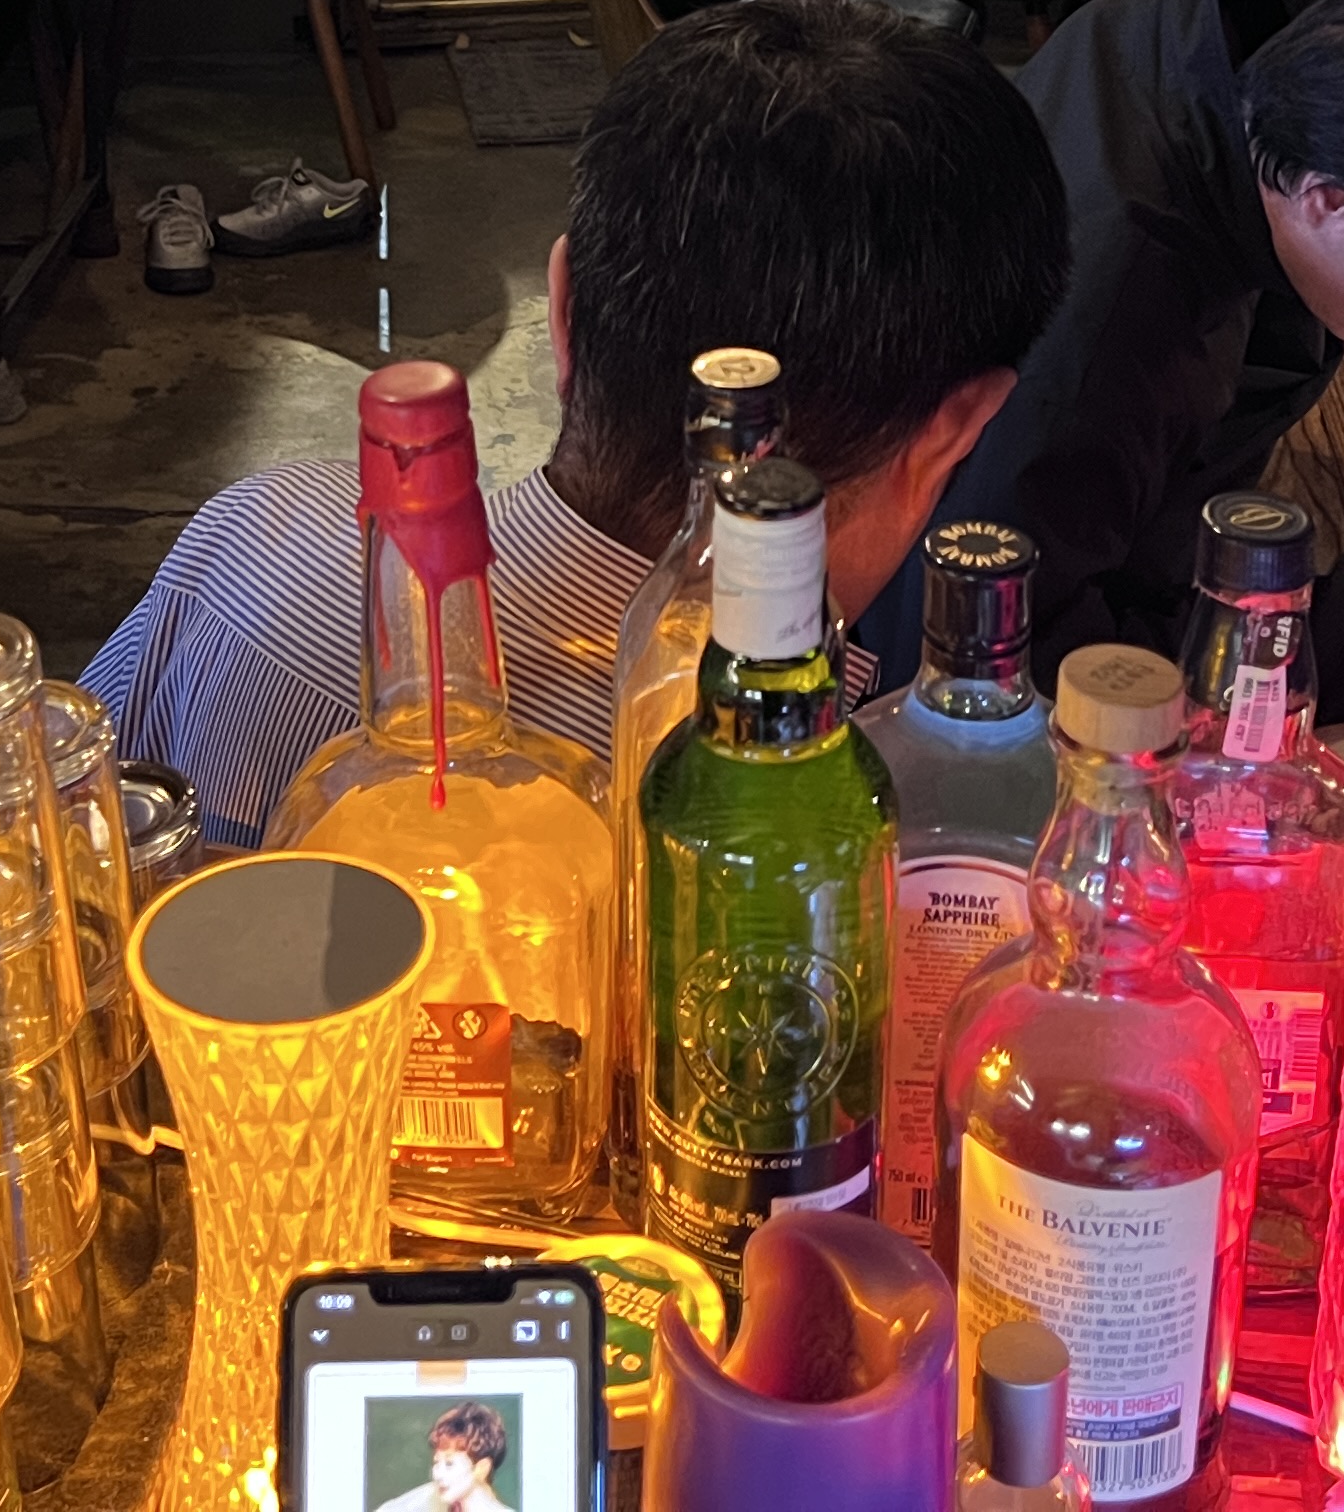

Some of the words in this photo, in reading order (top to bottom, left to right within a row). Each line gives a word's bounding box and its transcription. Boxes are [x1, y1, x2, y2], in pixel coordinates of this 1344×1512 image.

[1272, 615, 1294, 658] RFID
[927, 891, 1001, 911] BOMBAY
[921, 907, 1001, 929] SAPPHIRE
[909, 923, 963, 937] LONDON
[965, 928, 991, 940] DRY
[999, 1195, 1036, 1223] THE
[1042, 1208, 1166, 1238] BALVENIE
[1067, 1396, 1118, 1417] 년에게
[1122, 1391, 1179, 1417] 판매금지
